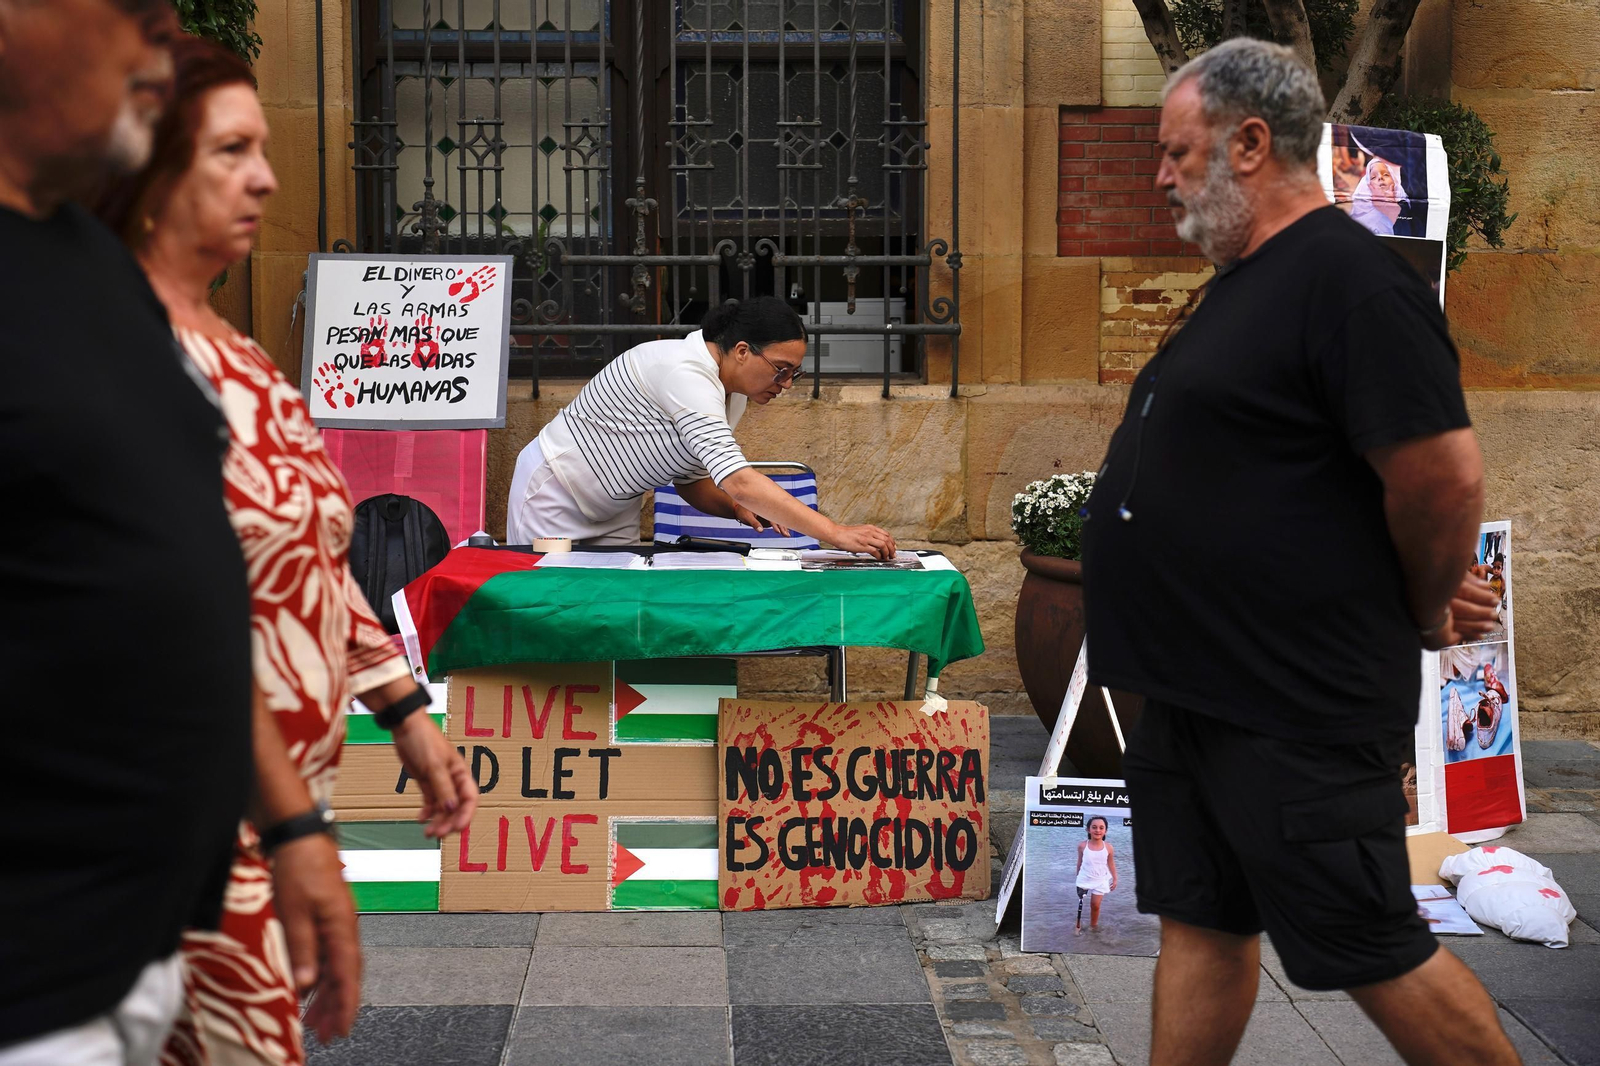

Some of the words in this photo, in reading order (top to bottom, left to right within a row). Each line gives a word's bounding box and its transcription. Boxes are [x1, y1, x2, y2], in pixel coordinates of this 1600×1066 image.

[362, 266, 392, 282] EL
[394, 266, 456, 282] DINERO
[400, 284, 415, 299] Y
[353, 302, 391, 316] LAS
[401, 303, 470, 318] ARMAS
[326, 326, 386, 345] PESAN
[389, 326, 433, 343] MAS
[441, 327, 480, 346] QUE
[334, 353, 373, 374] QUE
[379, 353, 411, 369] LAS
[418, 352, 477, 371] VIDAS
[357, 376, 469, 404] HUMANAS
[464, 684, 600, 740] LIVE
[521, 746, 622, 800] LET
[725, 746, 784, 801] NO
[791, 746, 841, 801] ES
[846, 746, 985, 803] GUERRA
[1042, 789, 1085, 802] ابتسامتها
[1103, 791, 1115, 804] لم
[459, 813, 598, 874] LIVE
[726, 816, 769, 872] ES
[778, 817, 978, 872] GENOCIDIO
